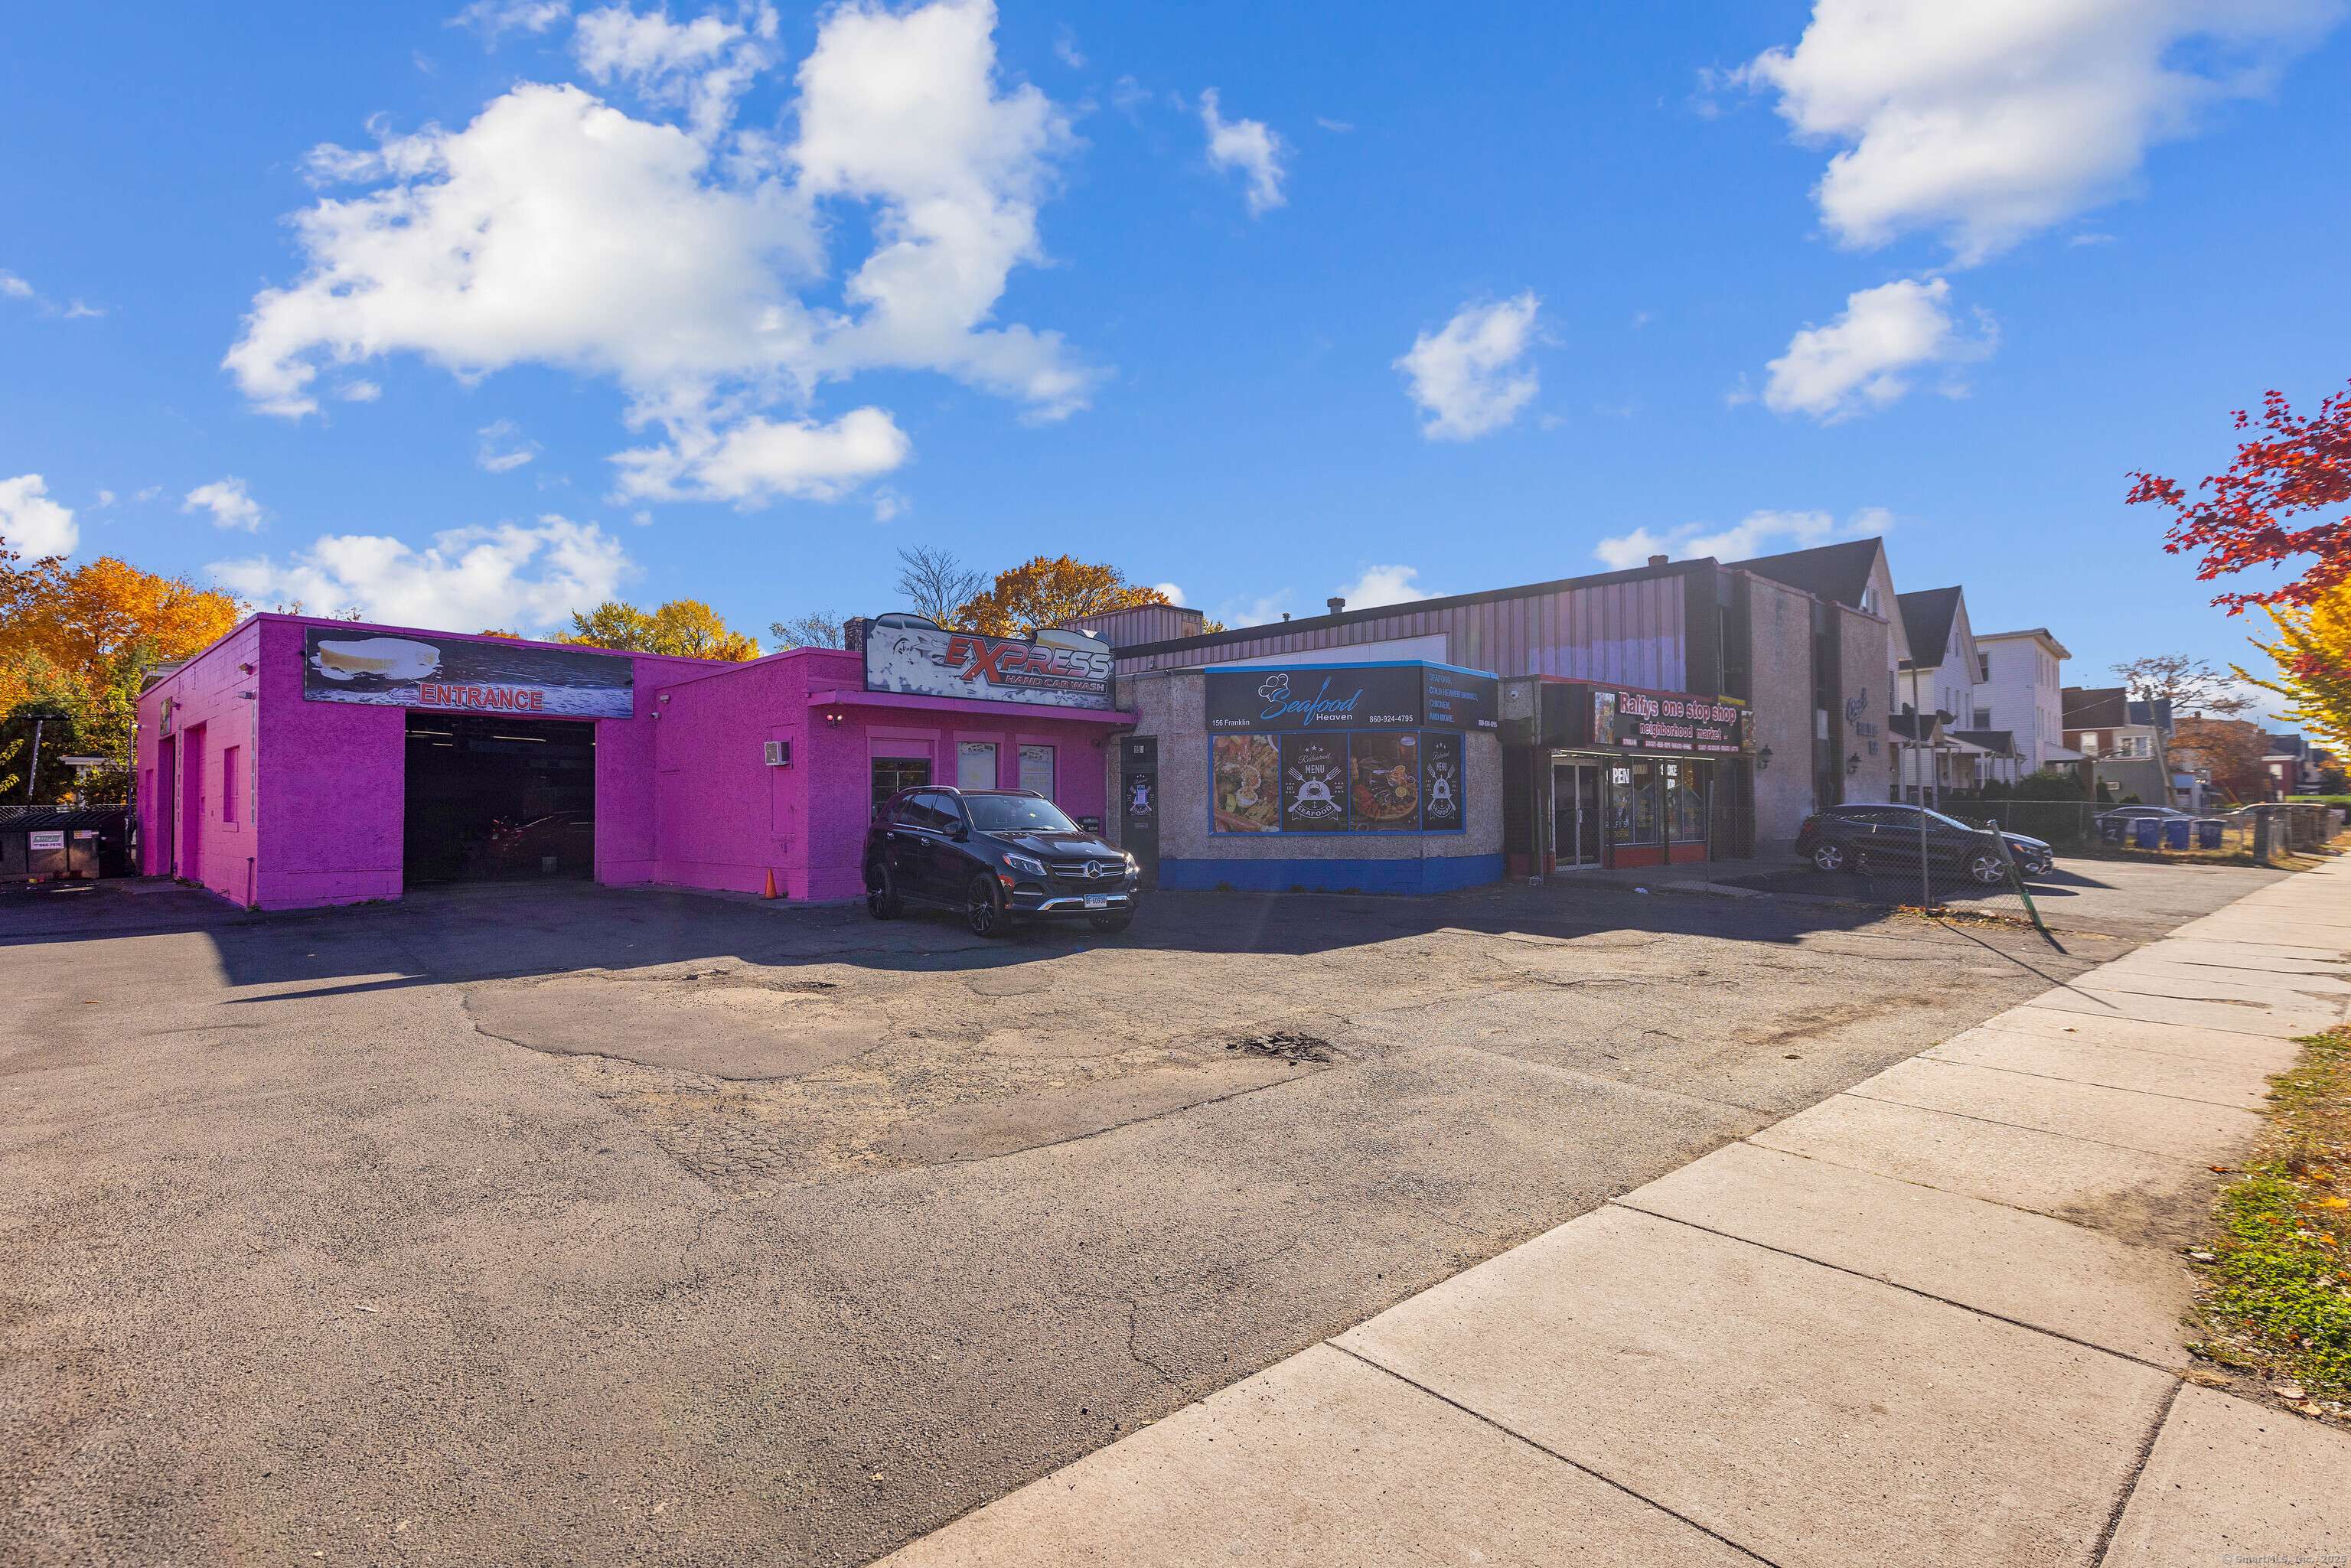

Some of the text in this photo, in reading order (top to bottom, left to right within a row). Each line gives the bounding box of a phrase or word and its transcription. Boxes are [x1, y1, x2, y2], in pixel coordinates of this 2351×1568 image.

[944, 634, 1114, 684] EXPRESS
[1005, 675, 1105, 692] HAND CAR WASH
[419, 683, 544, 710] ENTRANCE
[1260, 676, 1364, 726] Seafood
[1316, 712, 1353, 722] Heaven
[1619, 692, 1736, 725] Ralfys one stop shop
[1368, 715, 1414, 723] 860-924-4795
[1639, 722, 1722, 740] neighborhood market
[1298, 753, 1332, 764] Restaurant
[1305, 764, 1325, 774] MENU
[1297, 804, 1332, 817] SEAFOOD
